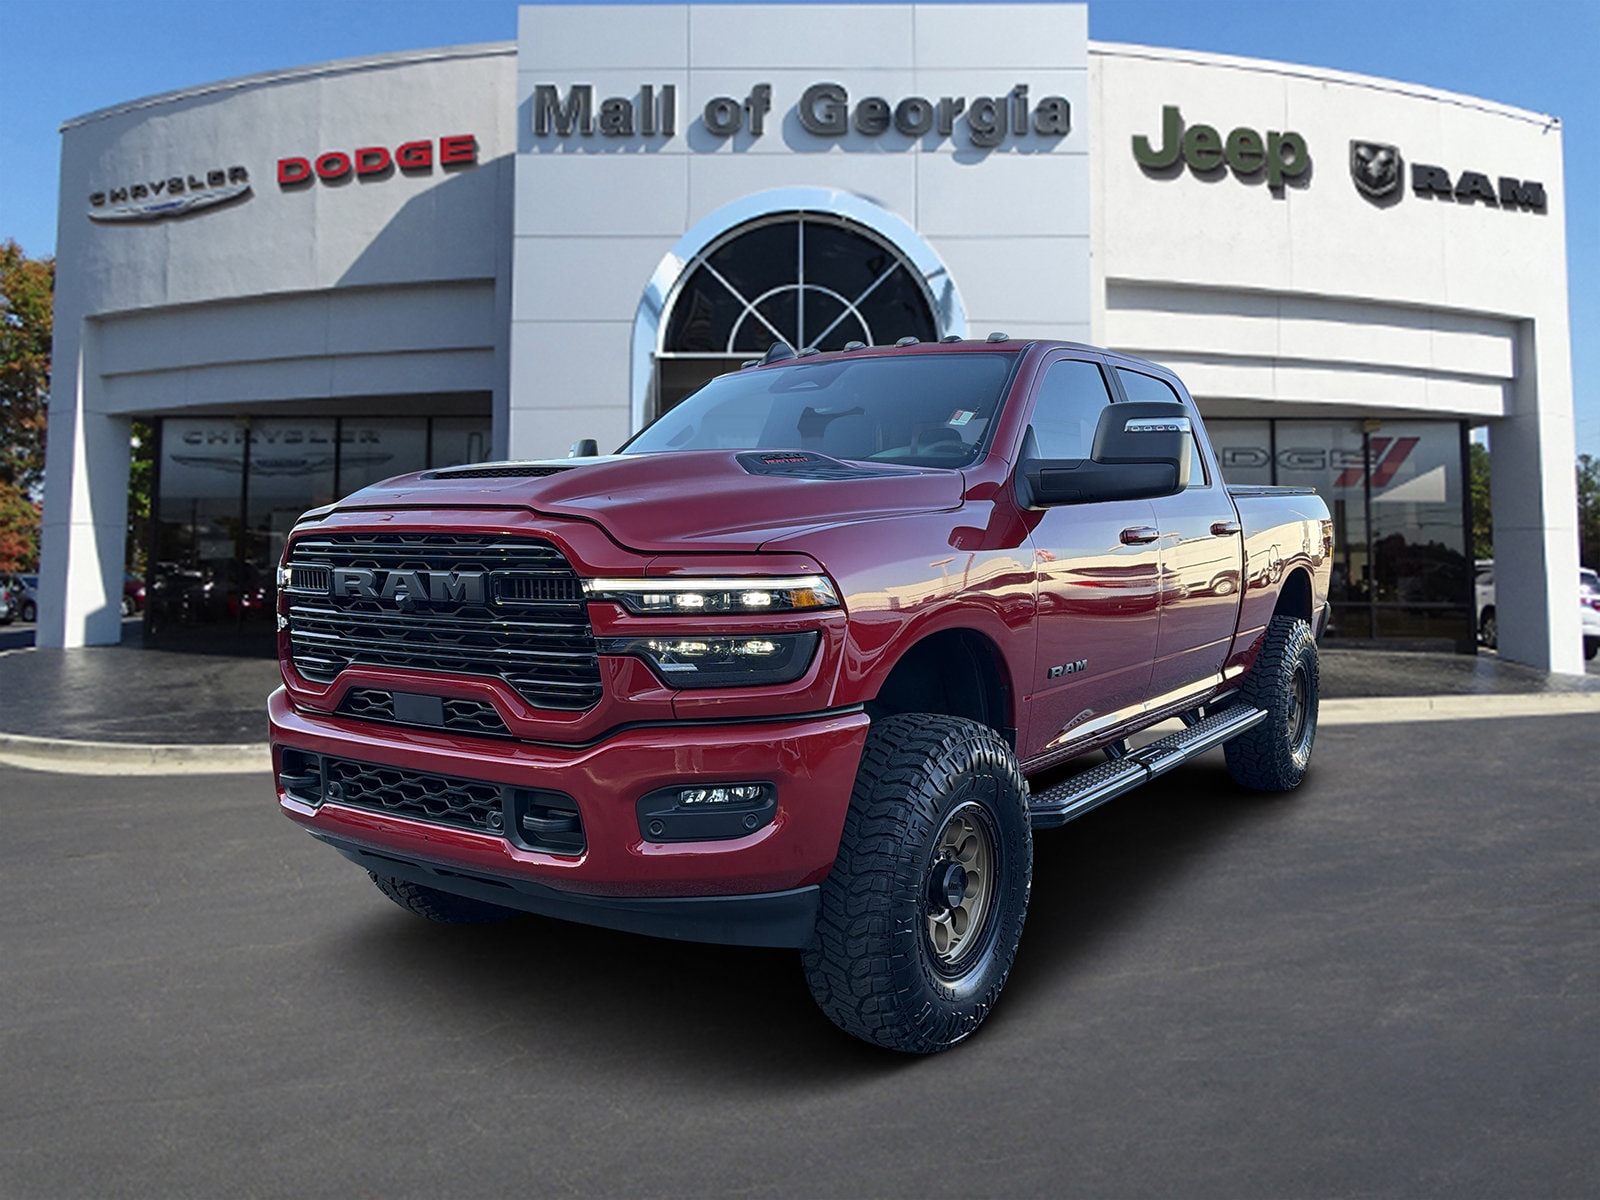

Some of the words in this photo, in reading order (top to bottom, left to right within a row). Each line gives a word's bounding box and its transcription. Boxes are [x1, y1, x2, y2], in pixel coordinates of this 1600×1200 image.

[532, 83, 677, 138] Mall
[703, 82, 772, 137] of
[798, 82, 1073, 149] Georgia
[276, 133, 478, 189] DODGE
[1131, 104, 1311, 197] Jeep
[88, 165, 250, 208] CHRYSLER
[1411, 162, 1548, 214] RAM
[334, 566, 486, 605] RAM
[1047, 659, 1088, 680] RAM
